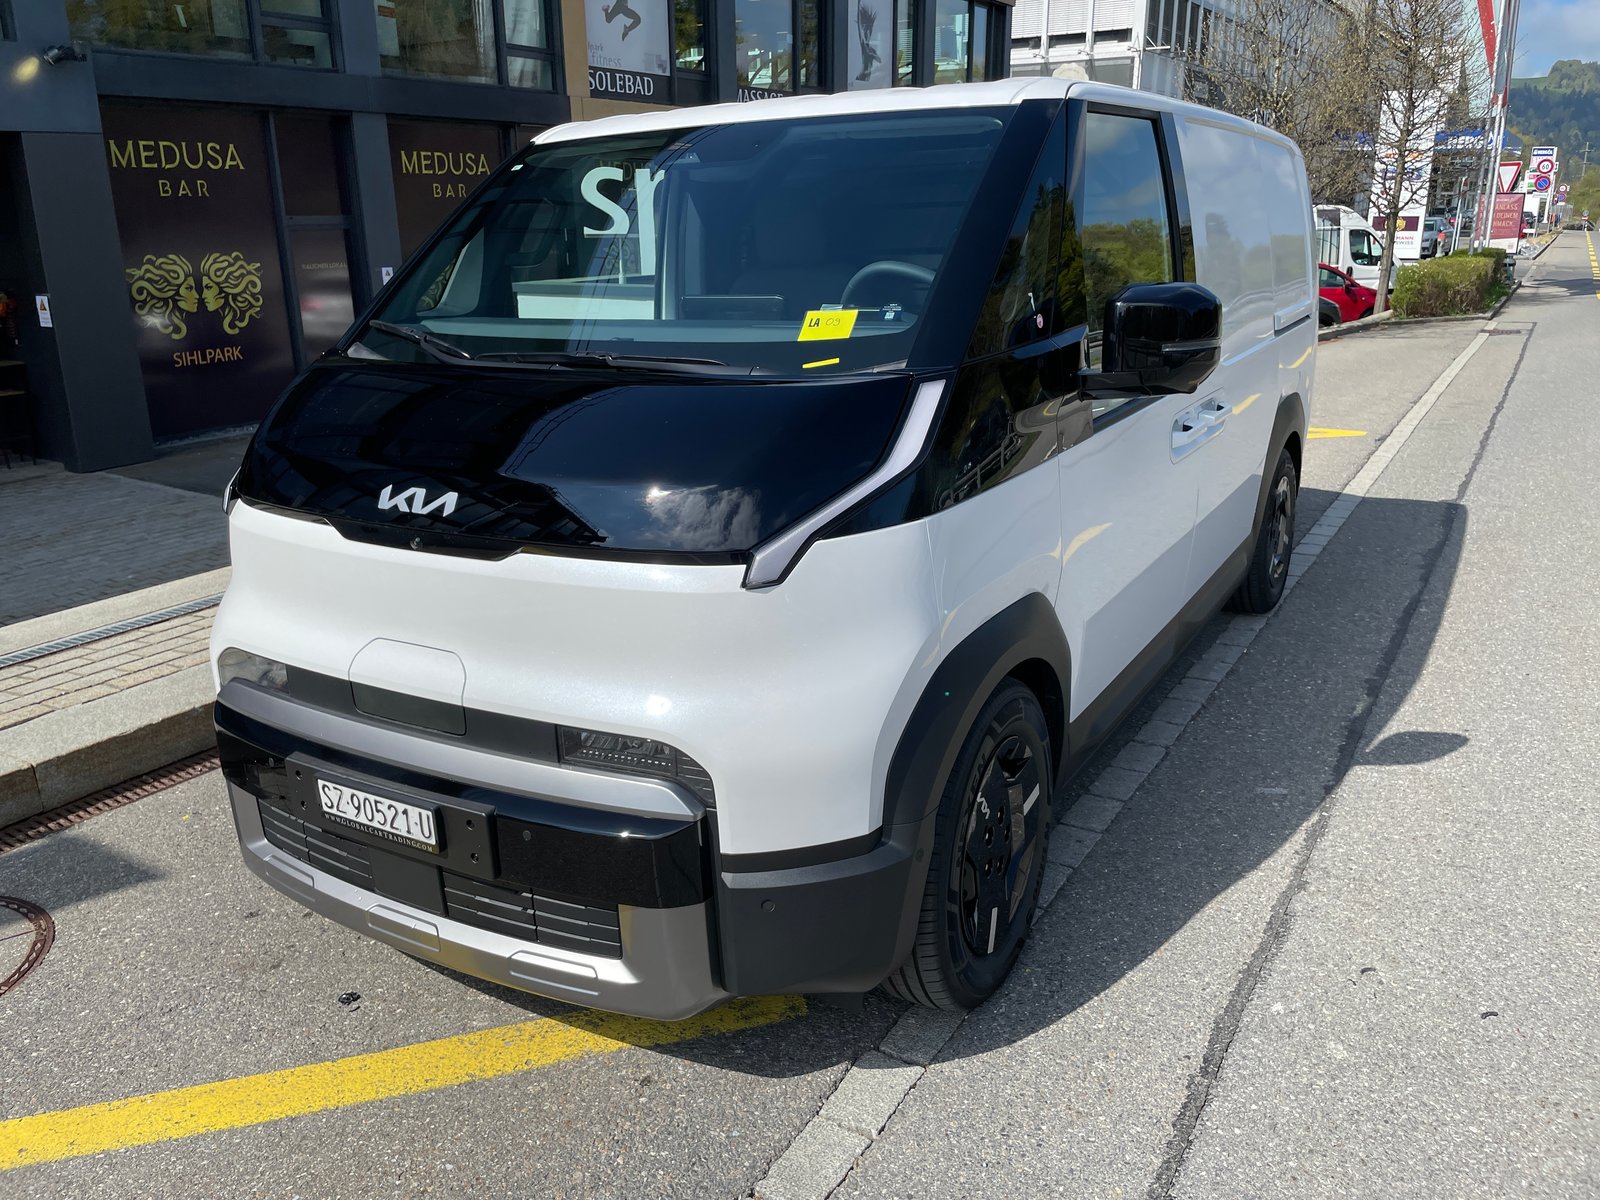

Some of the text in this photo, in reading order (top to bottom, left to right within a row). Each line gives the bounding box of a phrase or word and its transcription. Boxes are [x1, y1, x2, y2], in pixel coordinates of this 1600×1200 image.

[588, 70, 654, 96] SOLEBAD
[108, 139, 245, 170] MEDUSA
[400, 150, 491, 175] MEDUSA
[158, 179, 210, 197] BAR
[433, 183, 467, 198] BAR
[808, 317, 820, 328] LA
[173, 346, 243, 368] SIHLPARK
[377, 483, 459, 518] KIA
